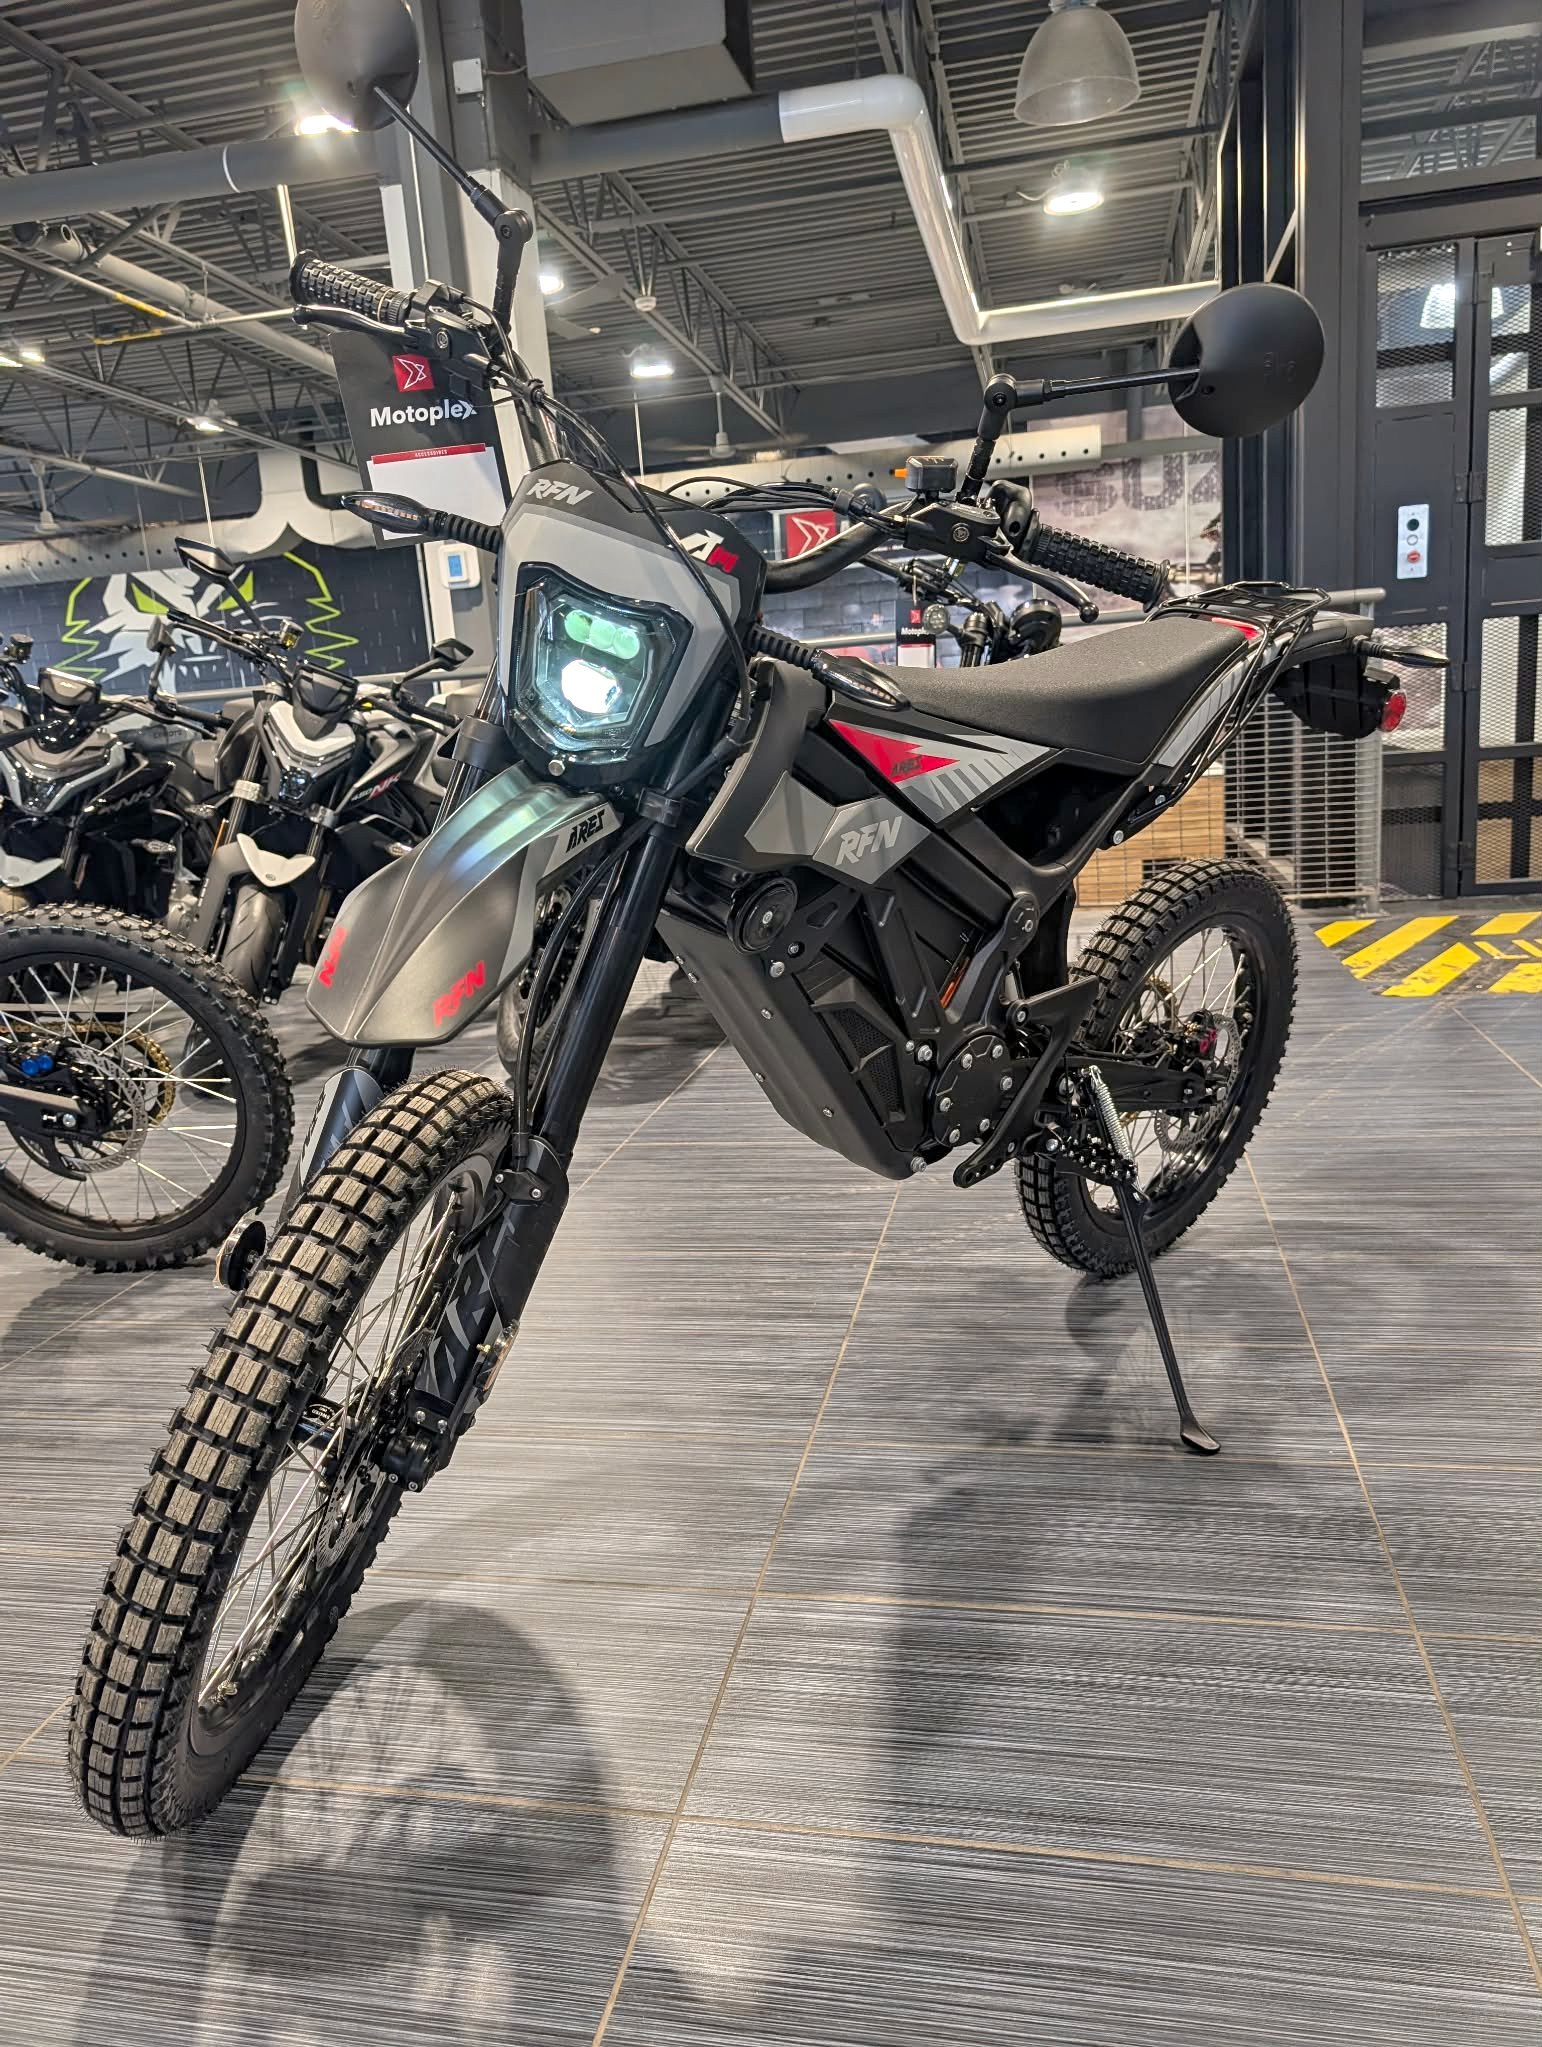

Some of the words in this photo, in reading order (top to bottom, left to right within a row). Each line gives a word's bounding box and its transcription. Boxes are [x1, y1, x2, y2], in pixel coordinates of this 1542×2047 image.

[370, 399, 478, 427] Motoplex
[526, 479, 594, 506] RFN
[835, 815, 903, 866] RFN
[432, 959, 486, 1028] RFN
